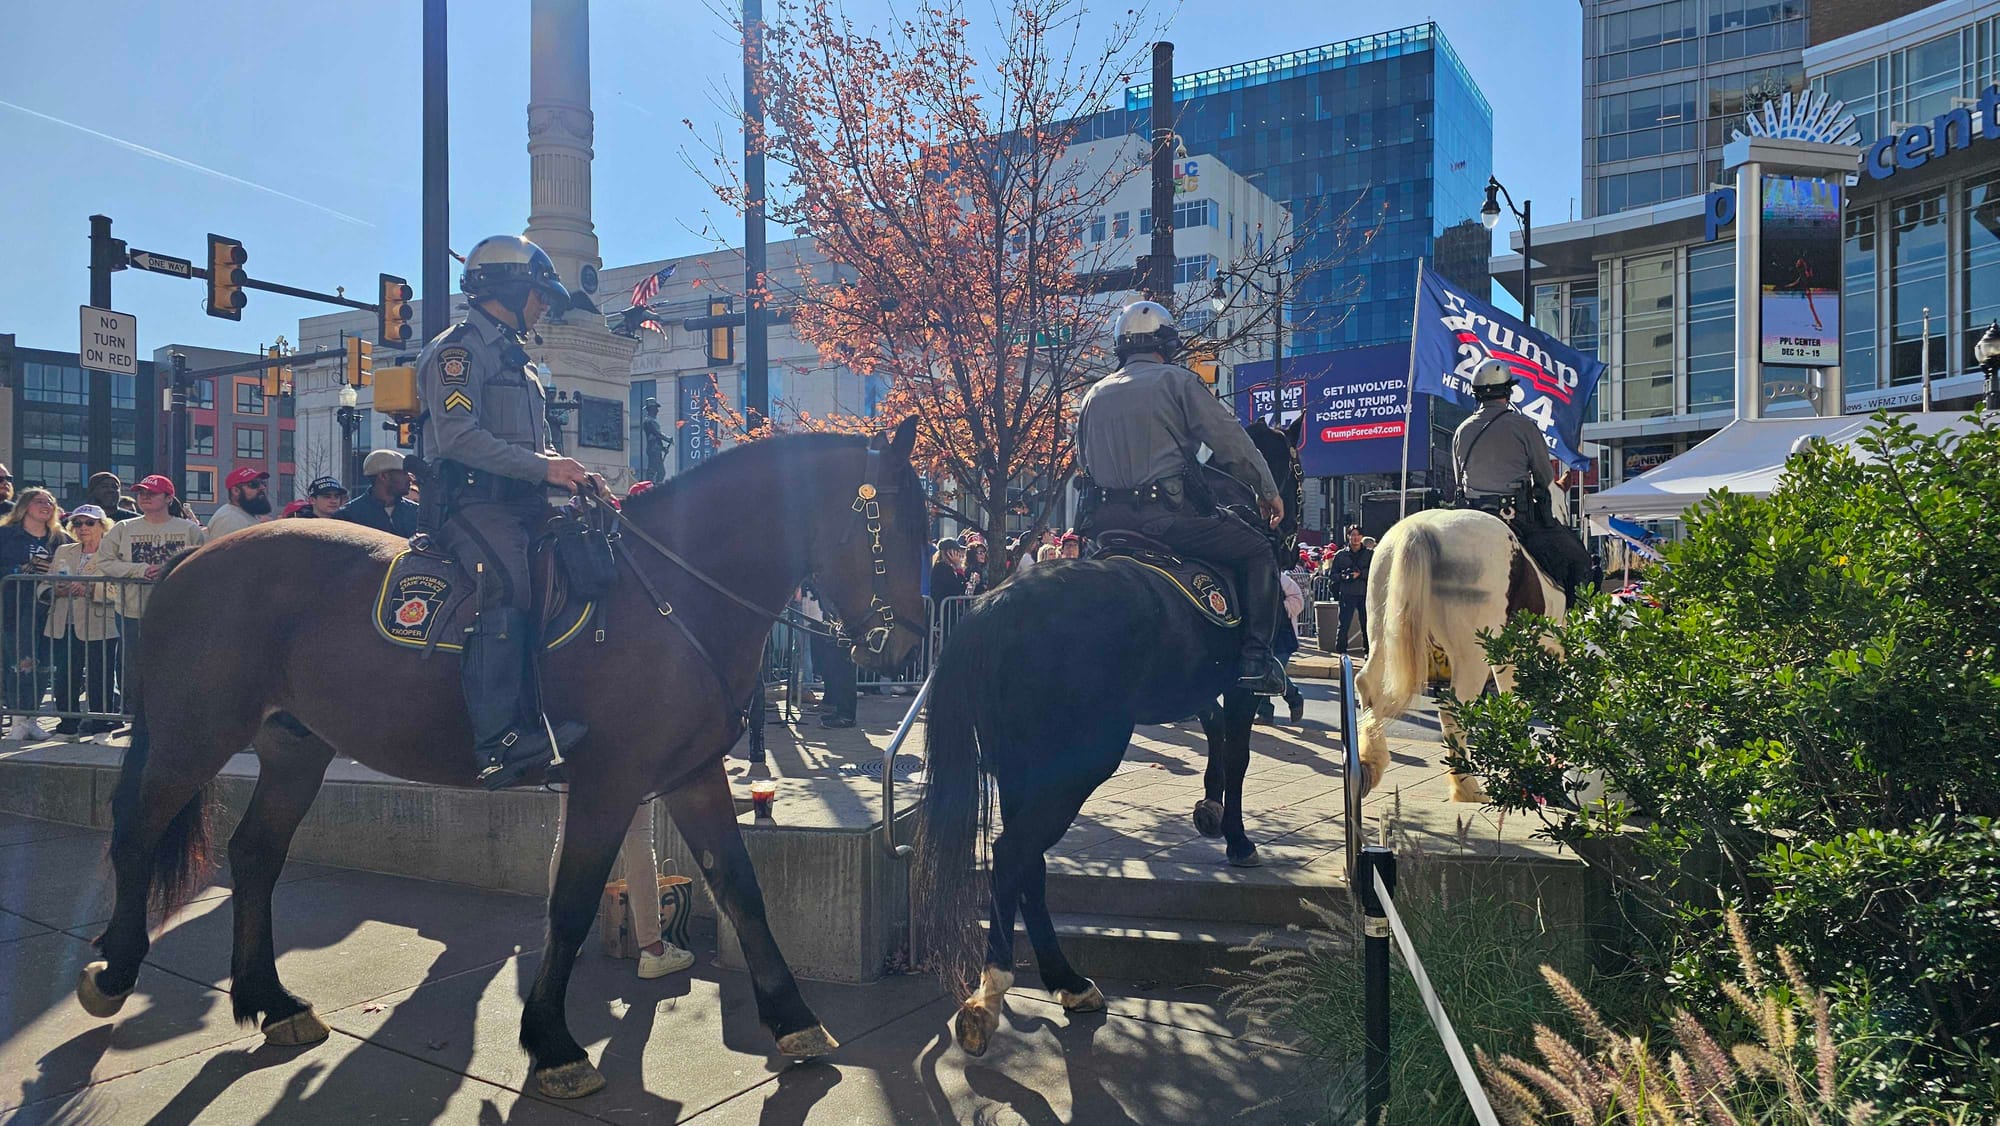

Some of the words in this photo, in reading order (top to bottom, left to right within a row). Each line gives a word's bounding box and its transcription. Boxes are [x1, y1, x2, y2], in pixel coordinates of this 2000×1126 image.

[148, 257, 166, 269] ONE
[168, 261, 185, 273] WAY
[100, 316, 118, 330] NO
[94, 332, 125, 349] TURN
[1779, 336, 1793, 346] PPL
[1794, 337, 1821, 347] CENTER
[86, 348, 103, 362] ON
[109, 352, 132, 367] RED
[1781, 347, 1795, 356] DEC
[1796, 348, 1805, 357] 12
[1812, 349, 1820, 357] 15
[1323, 386, 1345, 397] GET
[1347, 380, 1406, 395] INVOLVED.
[1442, 372, 1460, 390] HE
[1257, 399, 1299, 412] FOCE
[1330, 399, 1356, 411] JOIN
[1358, 395, 1397, 407] TRUMP
[1868, 396, 1896, 408] WFMZ
[1898, 394, 1909, 403] TV
[1316, 409, 1352, 423] FORCE
[1354, 407, 1368, 419] 47
[690, 388, 701, 460] SQUARE
[1326, 425, 1402, 439] TrumpForce47.com
